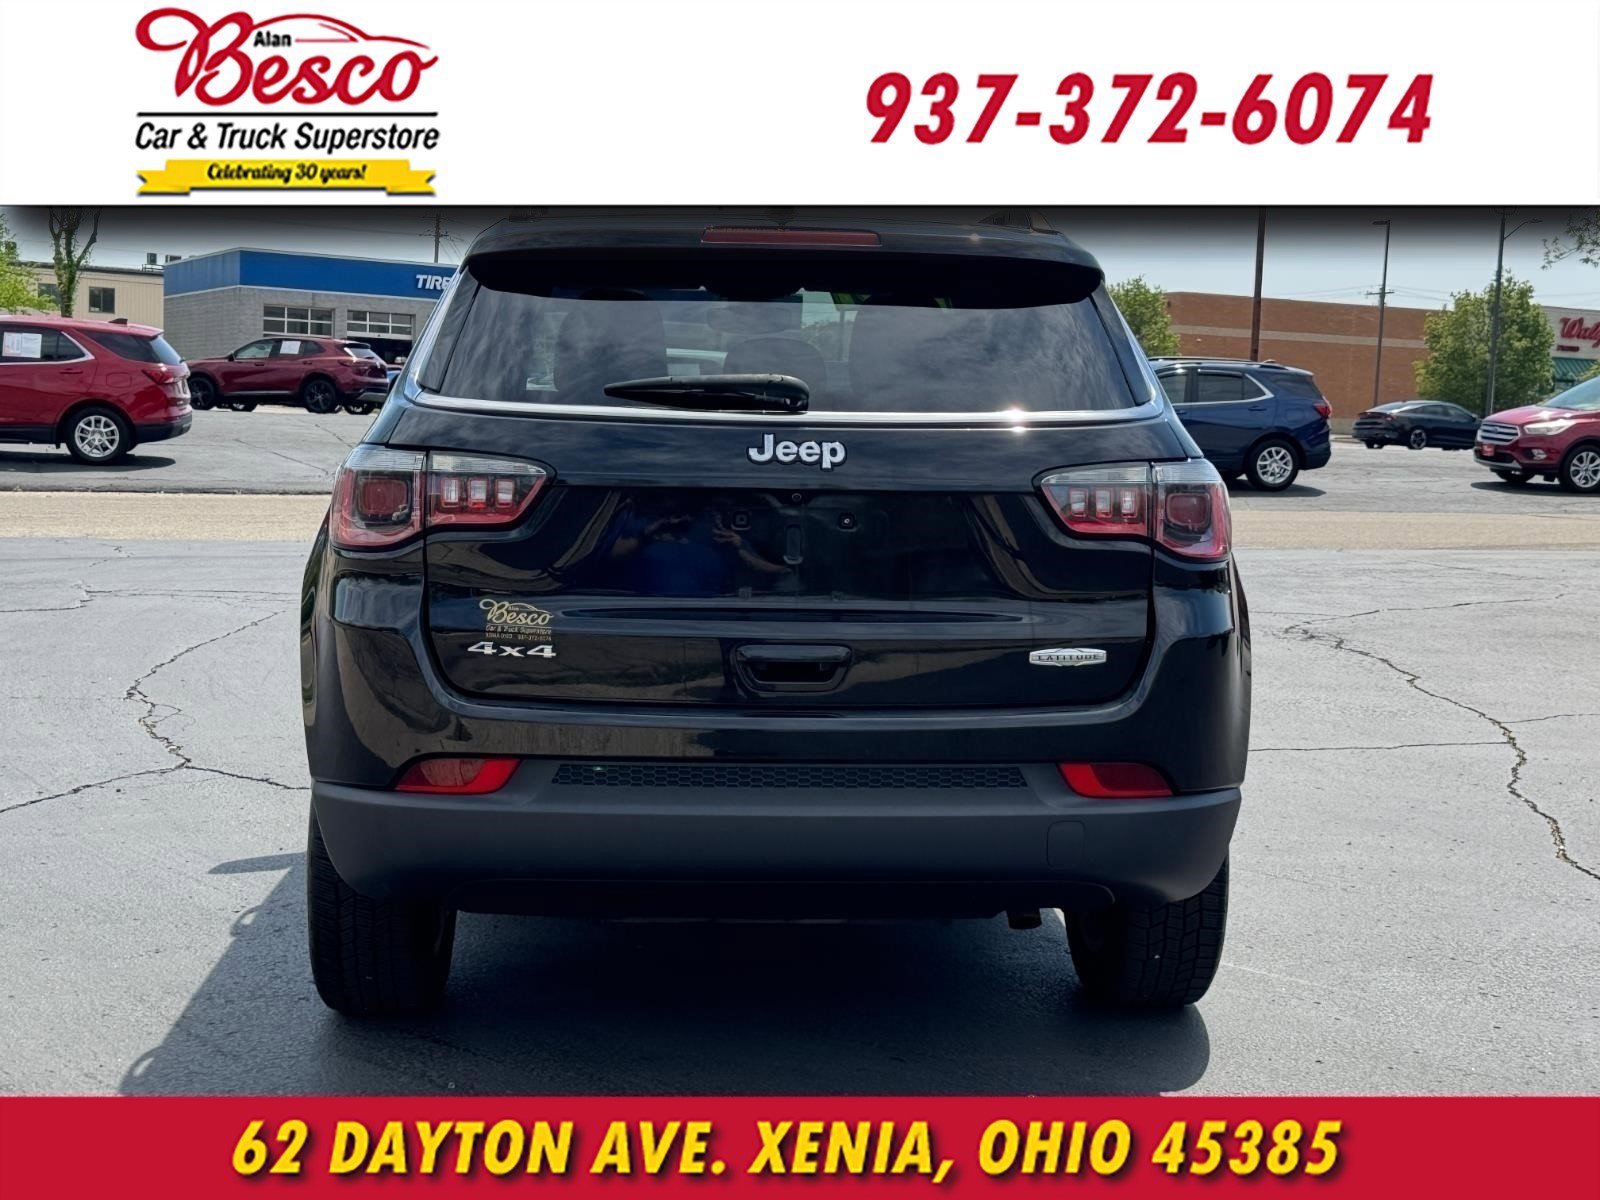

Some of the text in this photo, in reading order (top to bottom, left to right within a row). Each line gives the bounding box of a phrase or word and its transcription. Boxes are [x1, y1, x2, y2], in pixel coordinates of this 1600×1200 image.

[747, 433, 846, 469] Jeep
[479, 599, 554, 625] Besco
[467, 641, 557, 658] 4x4
